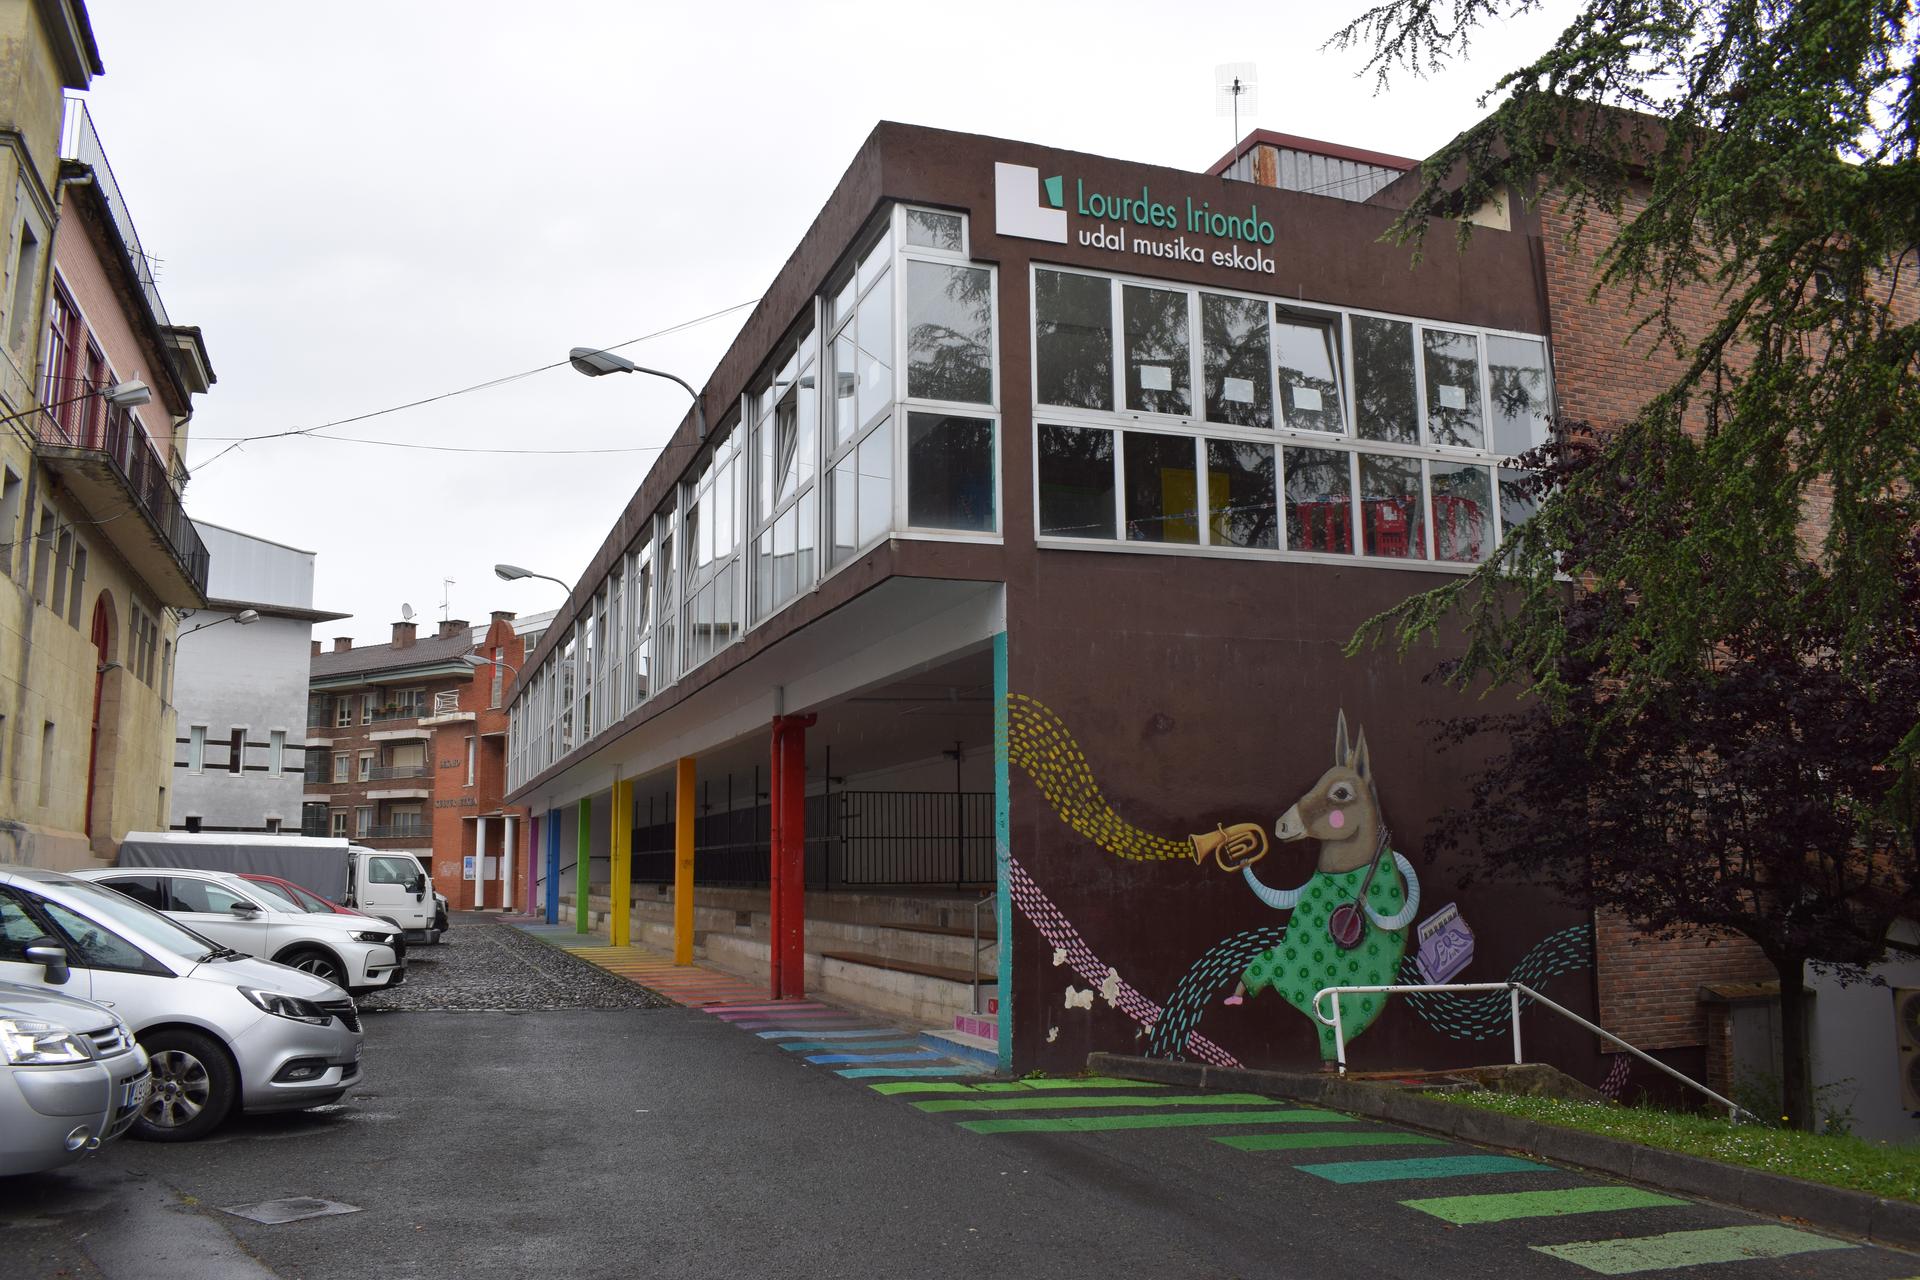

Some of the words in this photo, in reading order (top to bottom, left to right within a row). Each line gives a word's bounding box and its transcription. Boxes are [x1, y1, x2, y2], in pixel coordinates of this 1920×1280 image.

[1078, 178, 1177, 229] Lourdes
[1187, 196, 1275, 244] Iriondo
[1079, 224, 1125, 251] udal
[1133, 236, 1204, 263] musika
[1212, 245, 1275, 274] eskola
